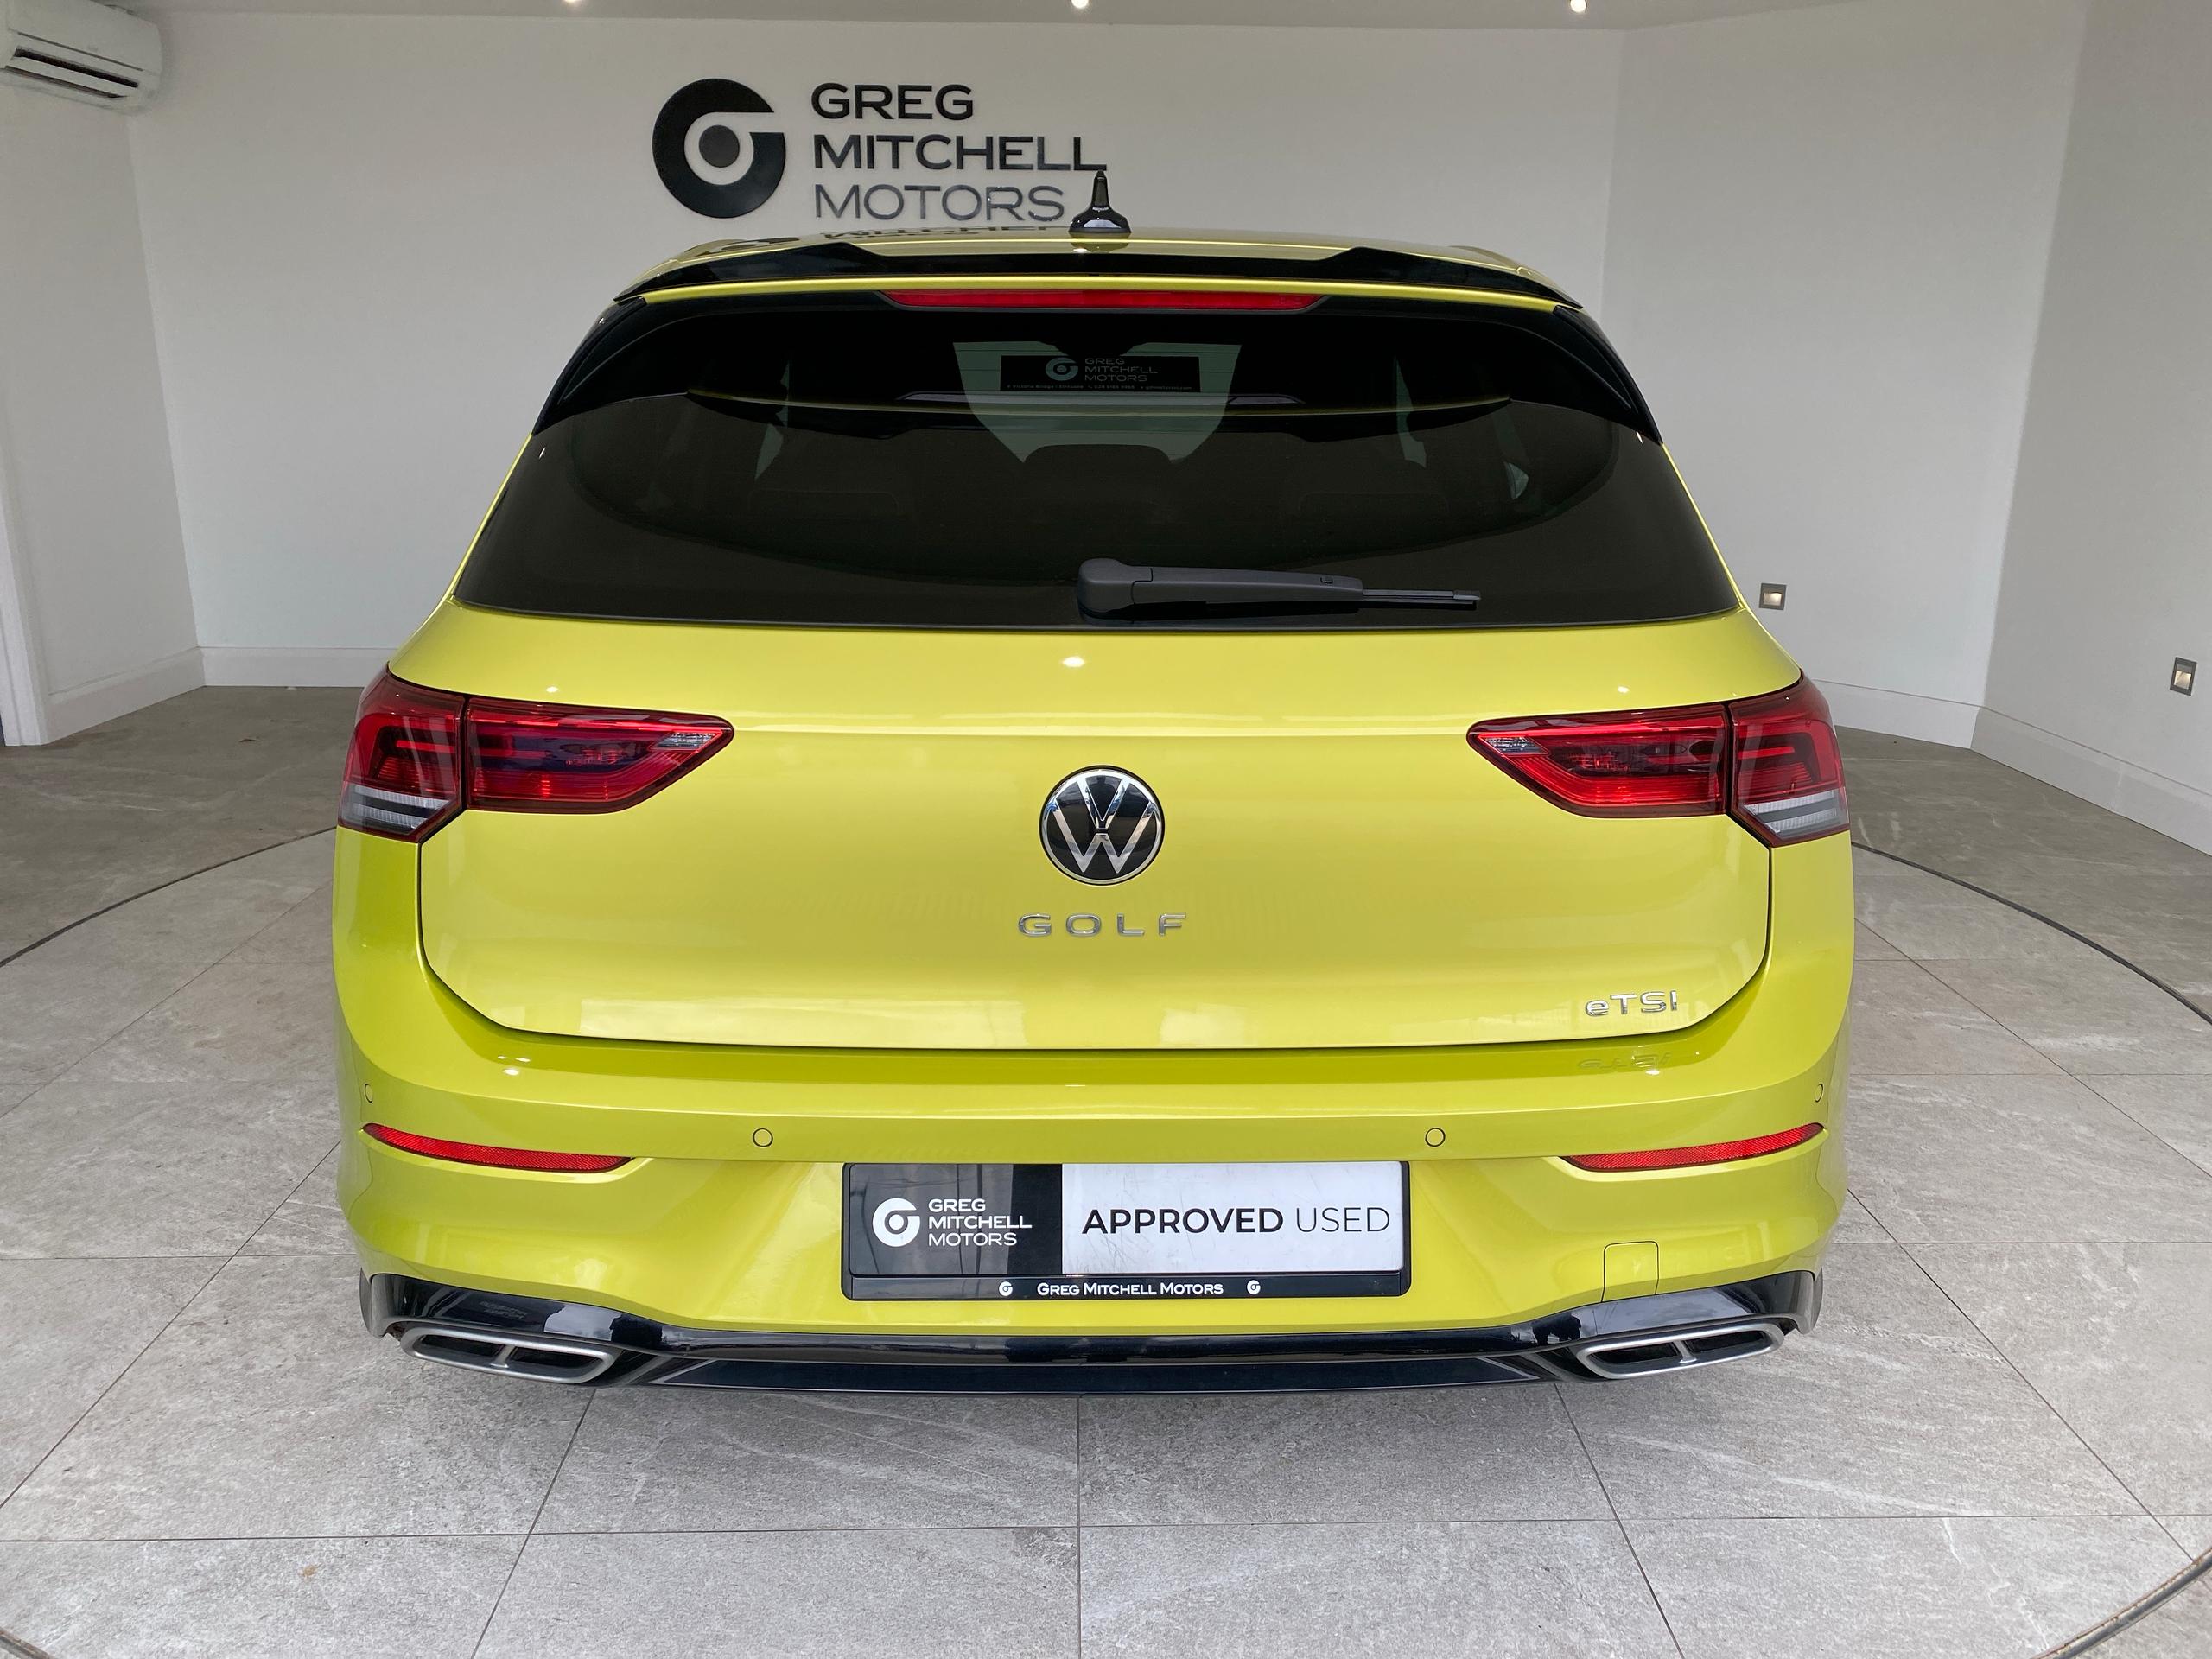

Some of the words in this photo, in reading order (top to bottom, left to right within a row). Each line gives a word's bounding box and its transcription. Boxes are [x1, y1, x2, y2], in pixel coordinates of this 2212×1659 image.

[810, 83, 974, 120] GREG
[813, 134, 1107, 171] MITCHELL
[815, 183, 1064, 221] MOTORS
[1084, 365, 1159, 374] MITCHELL
[1018, 913, 1186, 936] GOLF
[1585, 989, 1679, 1017] eTSI
[928, 1198, 987, 1213] GREG
[928, 1214, 1033, 1230] MITCHELL
[1082, 1207, 1284, 1234] APPROVED
[1295, 1206, 1391, 1233] USED
[928, 1231, 1017, 1247] MOTORS
